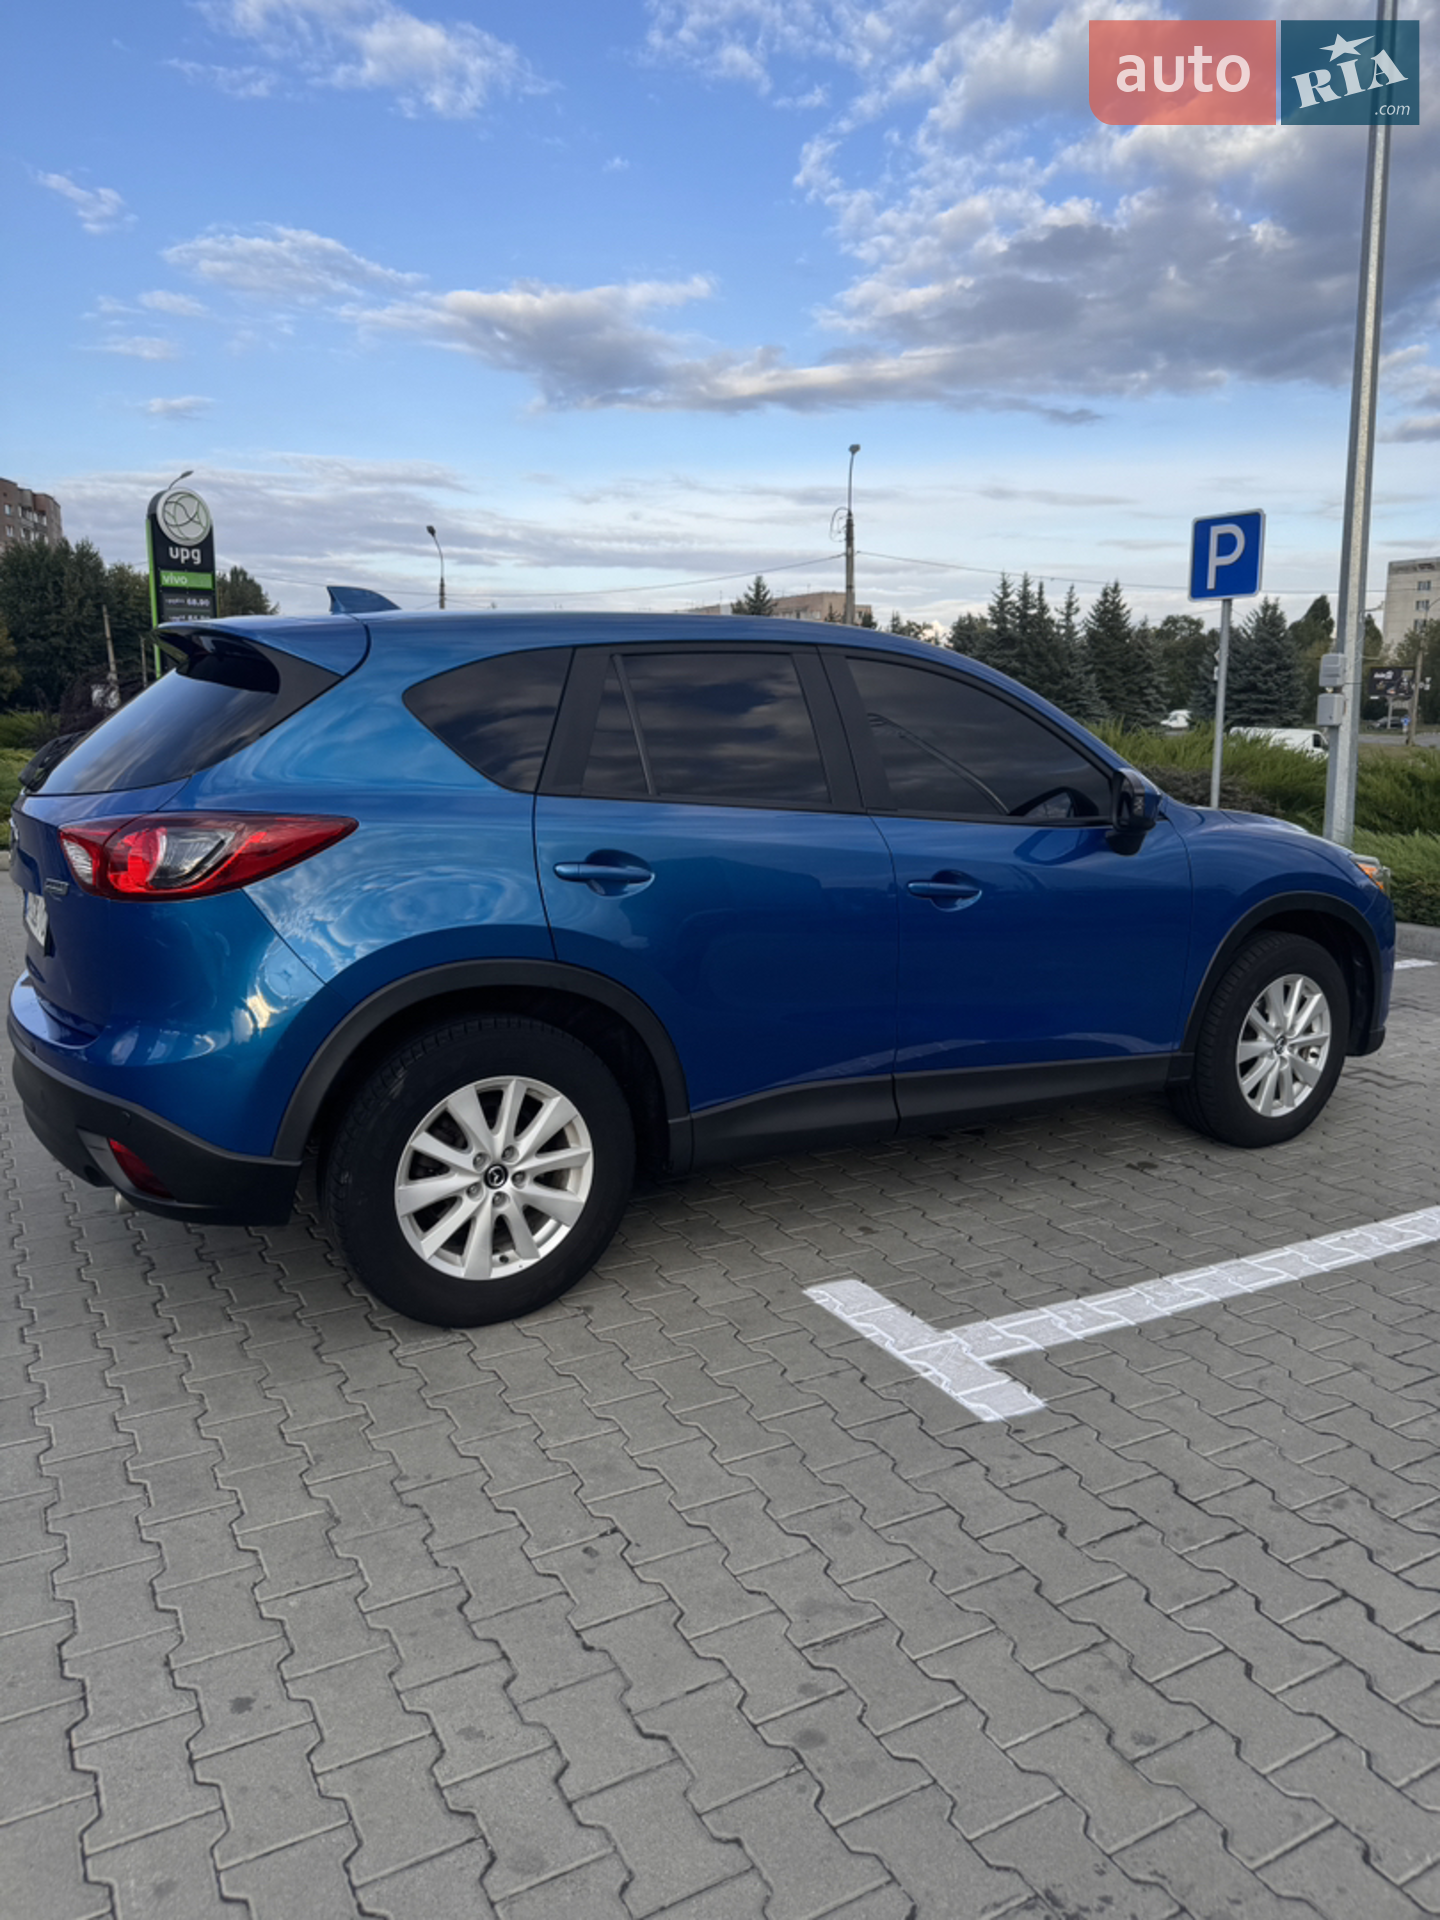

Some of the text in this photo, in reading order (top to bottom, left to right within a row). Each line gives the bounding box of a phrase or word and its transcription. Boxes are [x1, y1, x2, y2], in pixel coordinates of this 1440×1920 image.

[168, 546, 202, 565] upg
[1206, 522, 1246, 591] P
[162, 573, 189, 585] vivo
